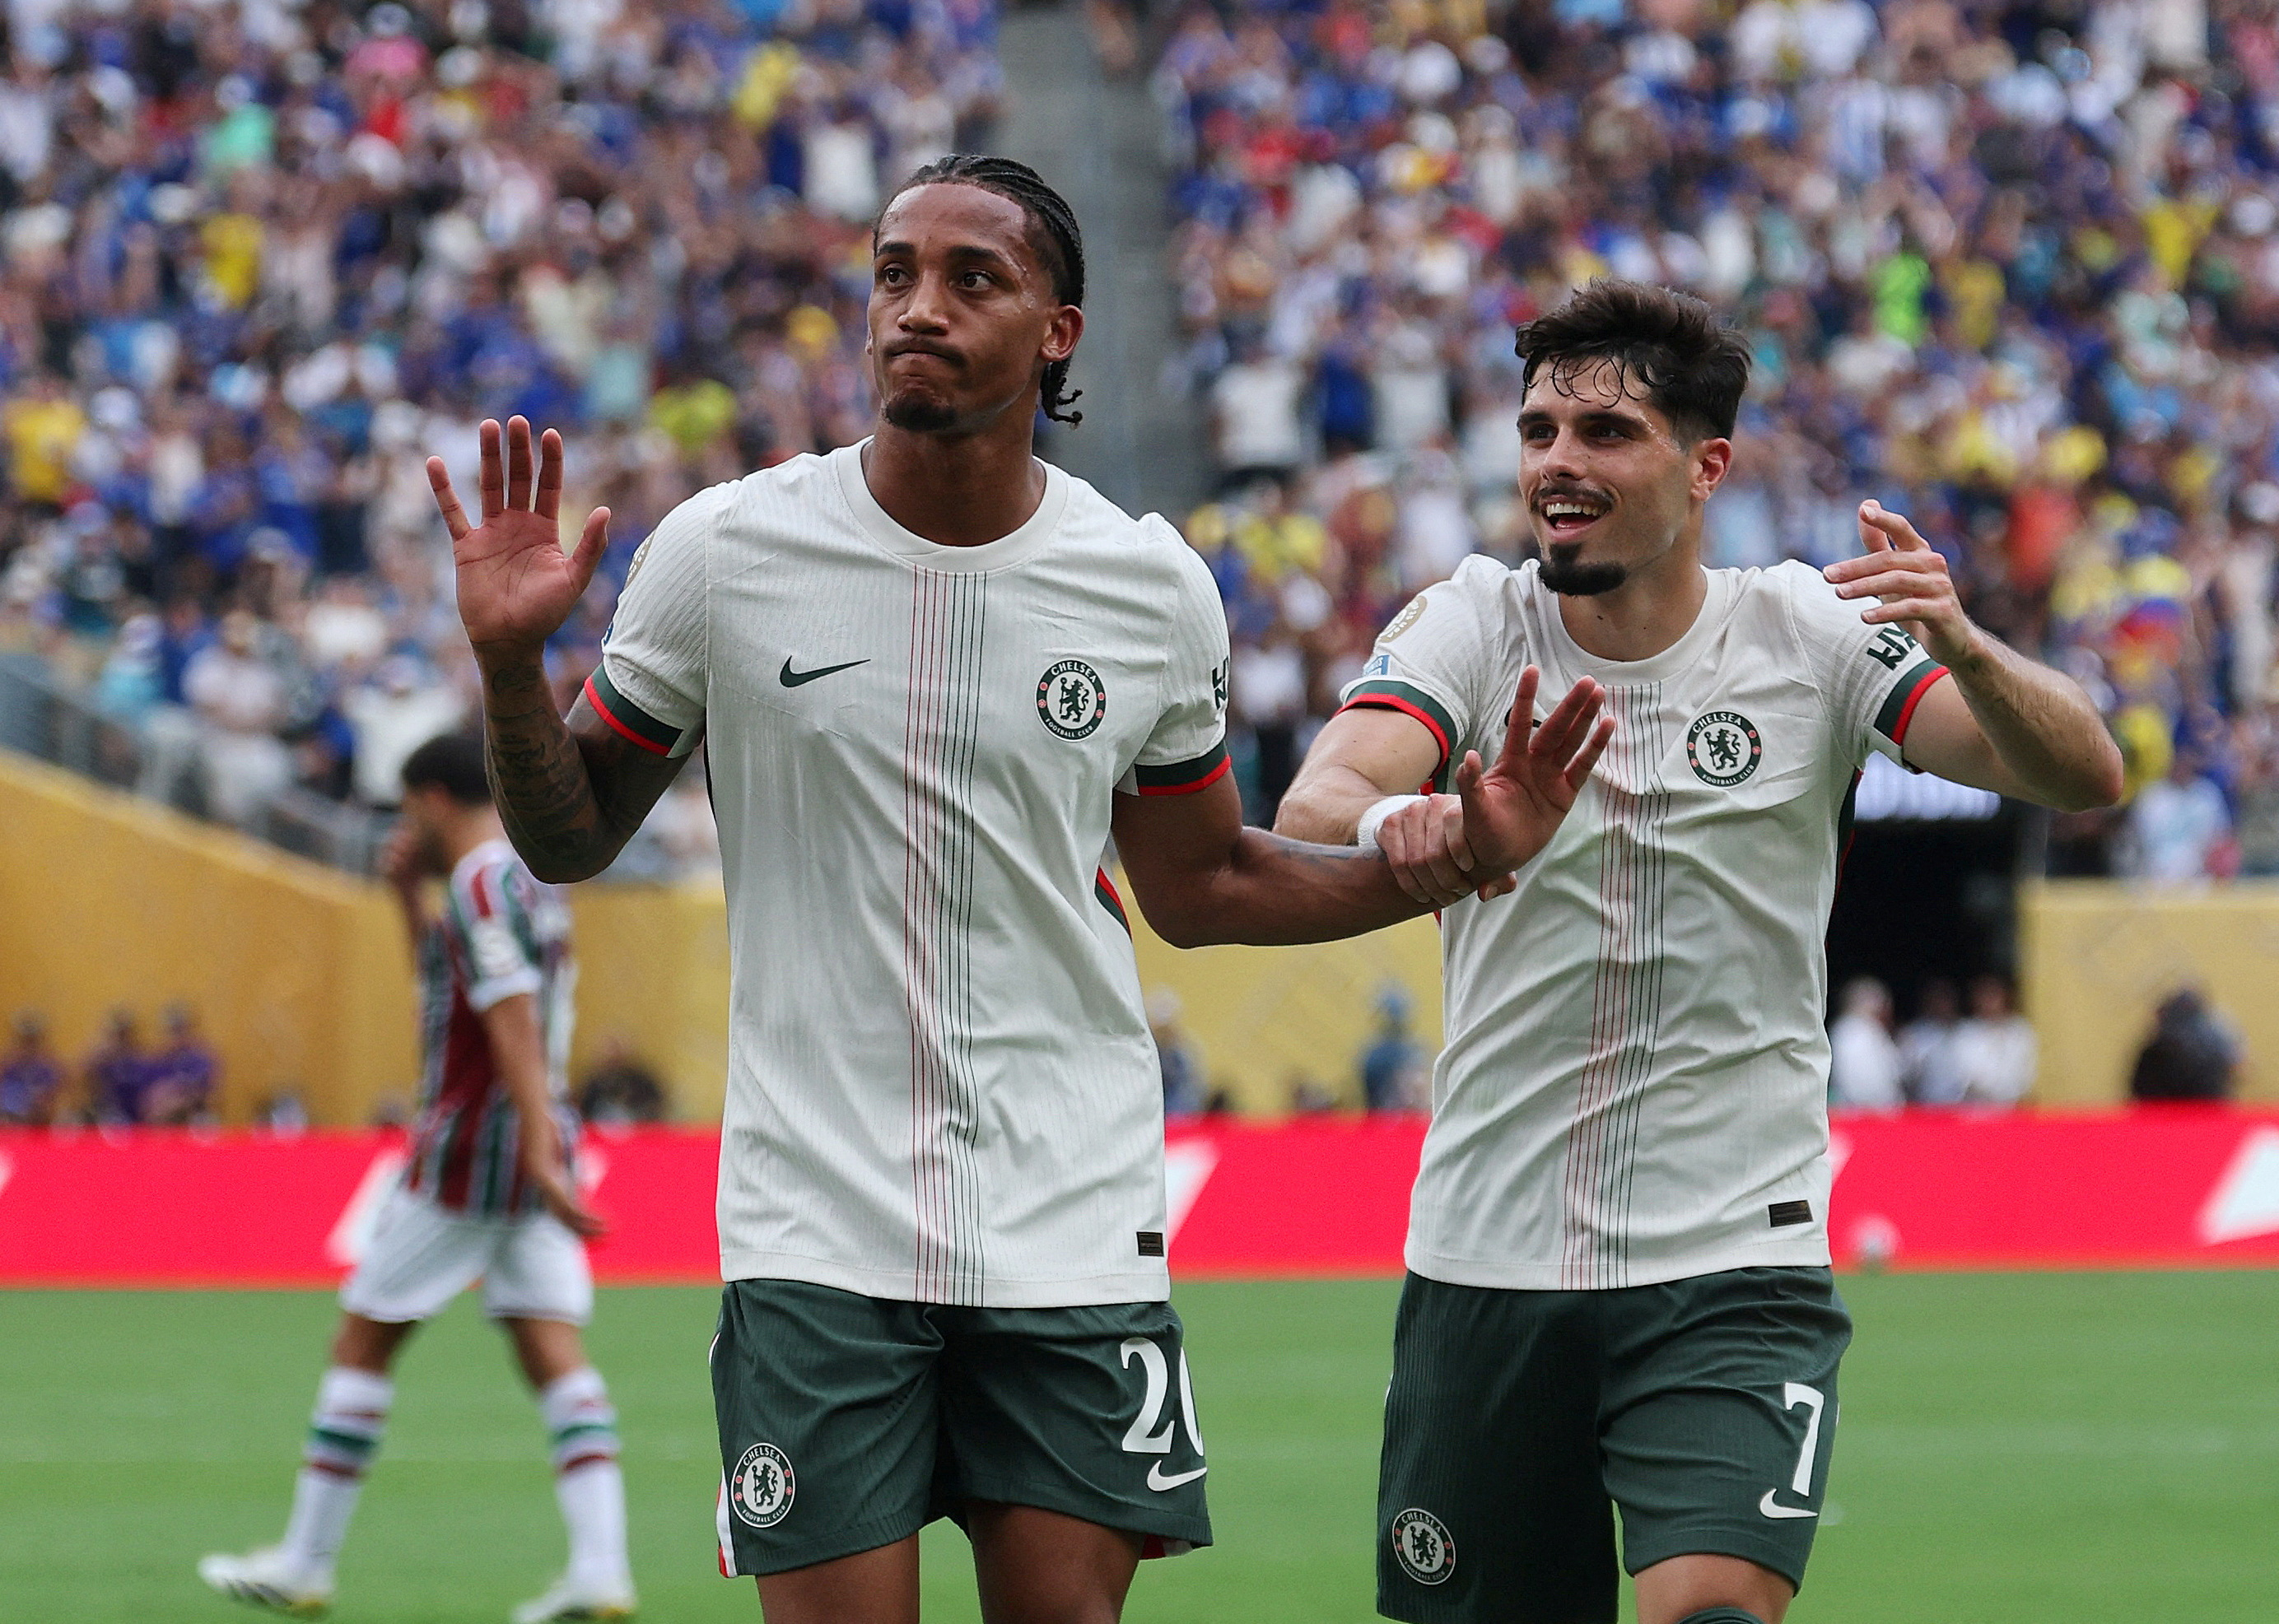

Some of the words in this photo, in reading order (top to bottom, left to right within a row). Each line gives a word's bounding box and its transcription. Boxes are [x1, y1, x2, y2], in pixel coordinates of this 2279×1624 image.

[1051, 661, 1097, 683] CHELSEA
[1045, 718, 1075, 738] FOOTBALL
[1692, 712, 1742, 733] CHELSEA
[1702, 774, 1738, 785] FOOTBALL
[1784, 1382, 1825, 1497] 7
[743, 1446, 781, 1466] CHELSEA
[742, 1509, 771, 1523] FOOTBALL
